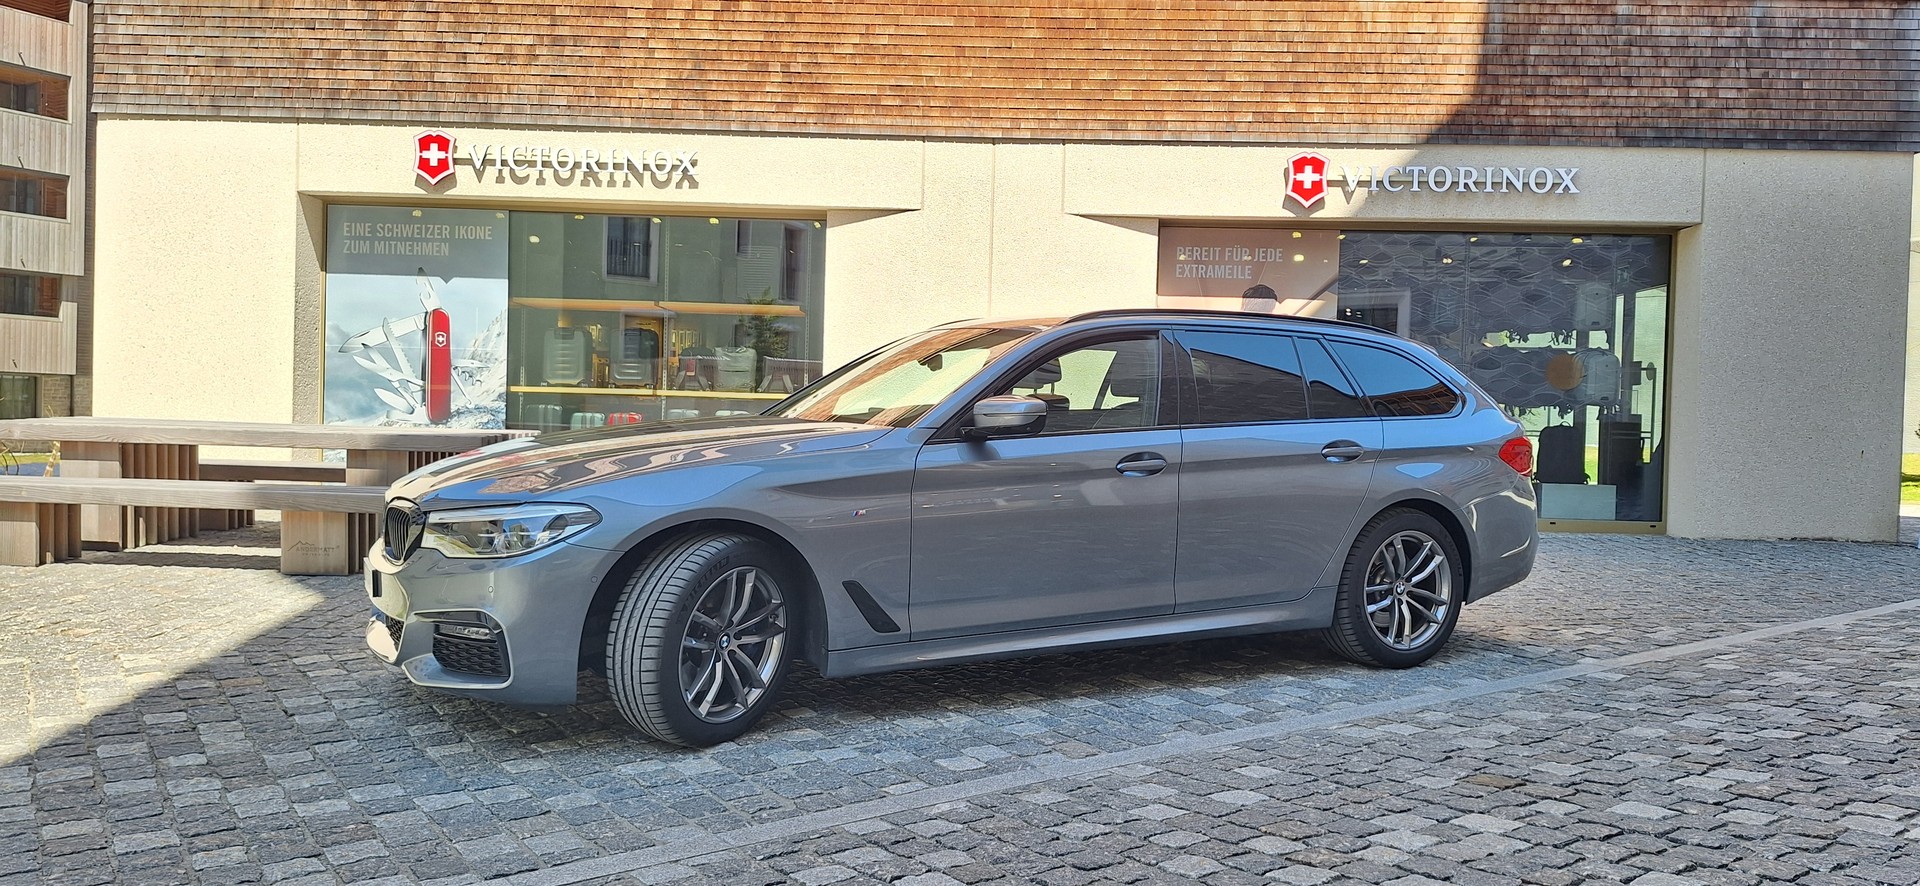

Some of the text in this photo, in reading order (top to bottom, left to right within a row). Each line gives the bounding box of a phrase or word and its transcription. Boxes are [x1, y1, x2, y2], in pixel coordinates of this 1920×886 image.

[469, 144, 699, 176] VICTORINOX
[1342, 165, 1580, 194] VICTORINOX
[343, 222, 492, 239] EINE SCHWEIZER IKONE
[343, 240, 449, 256] ZUM MITNEHMEN
[1176, 245, 1283, 262] BEREIT FÜR JEDE
[1176, 264, 1252, 279] EXTRAMEILE
